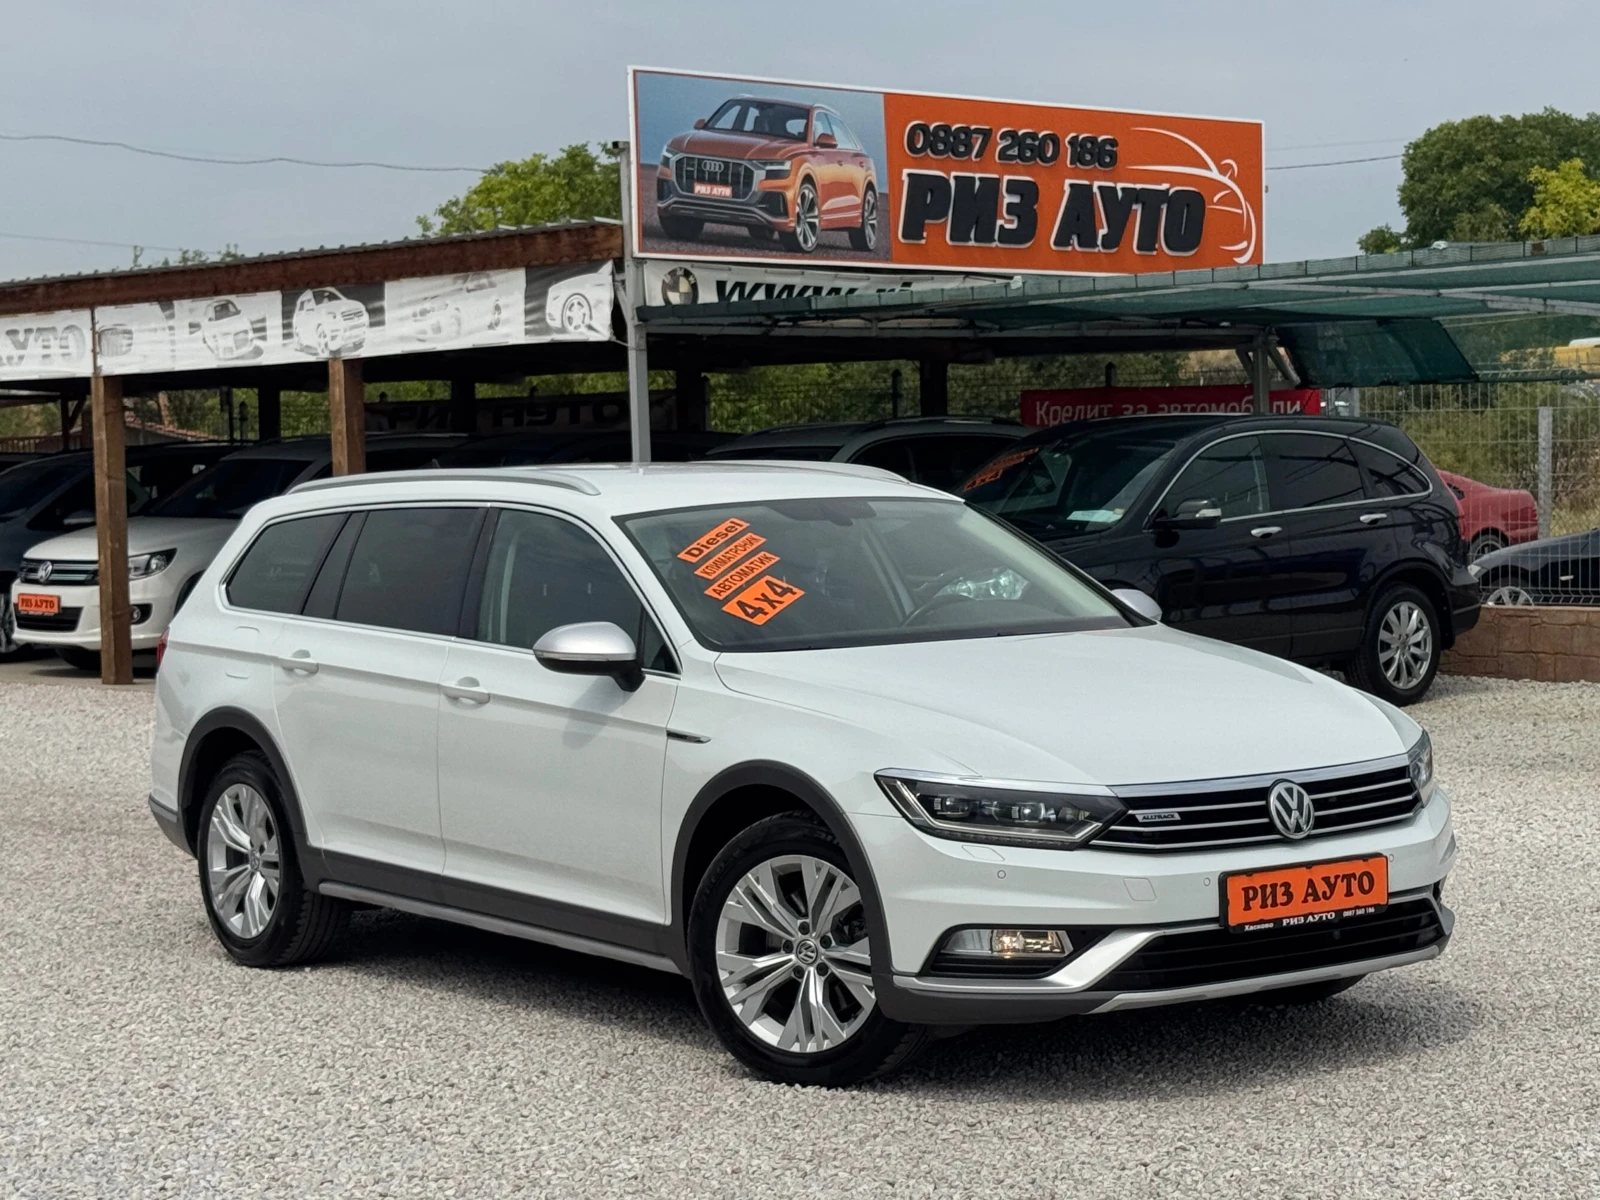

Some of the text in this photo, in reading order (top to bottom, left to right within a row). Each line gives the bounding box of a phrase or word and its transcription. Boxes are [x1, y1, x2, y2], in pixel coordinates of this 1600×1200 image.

[904, 121, 1119, 171] 0887 260 186
[898, 169, 1206, 257] РИЗ АУТО
[0, 324, 87, 366] УТО
[684, 520, 744, 558] Diesel
[701, 535, 760, 577] КЛИМАТРОНИК
[712, 553, 775, 596] АВТОМАТИК
[1141, 813, 1176, 821] ALLTRACK
[1241, 871, 1375, 911] РИЗ АУТО
[1282, 914, 1305, 926] РИЗ
[1306, 911, 1335, 924] АУТО
